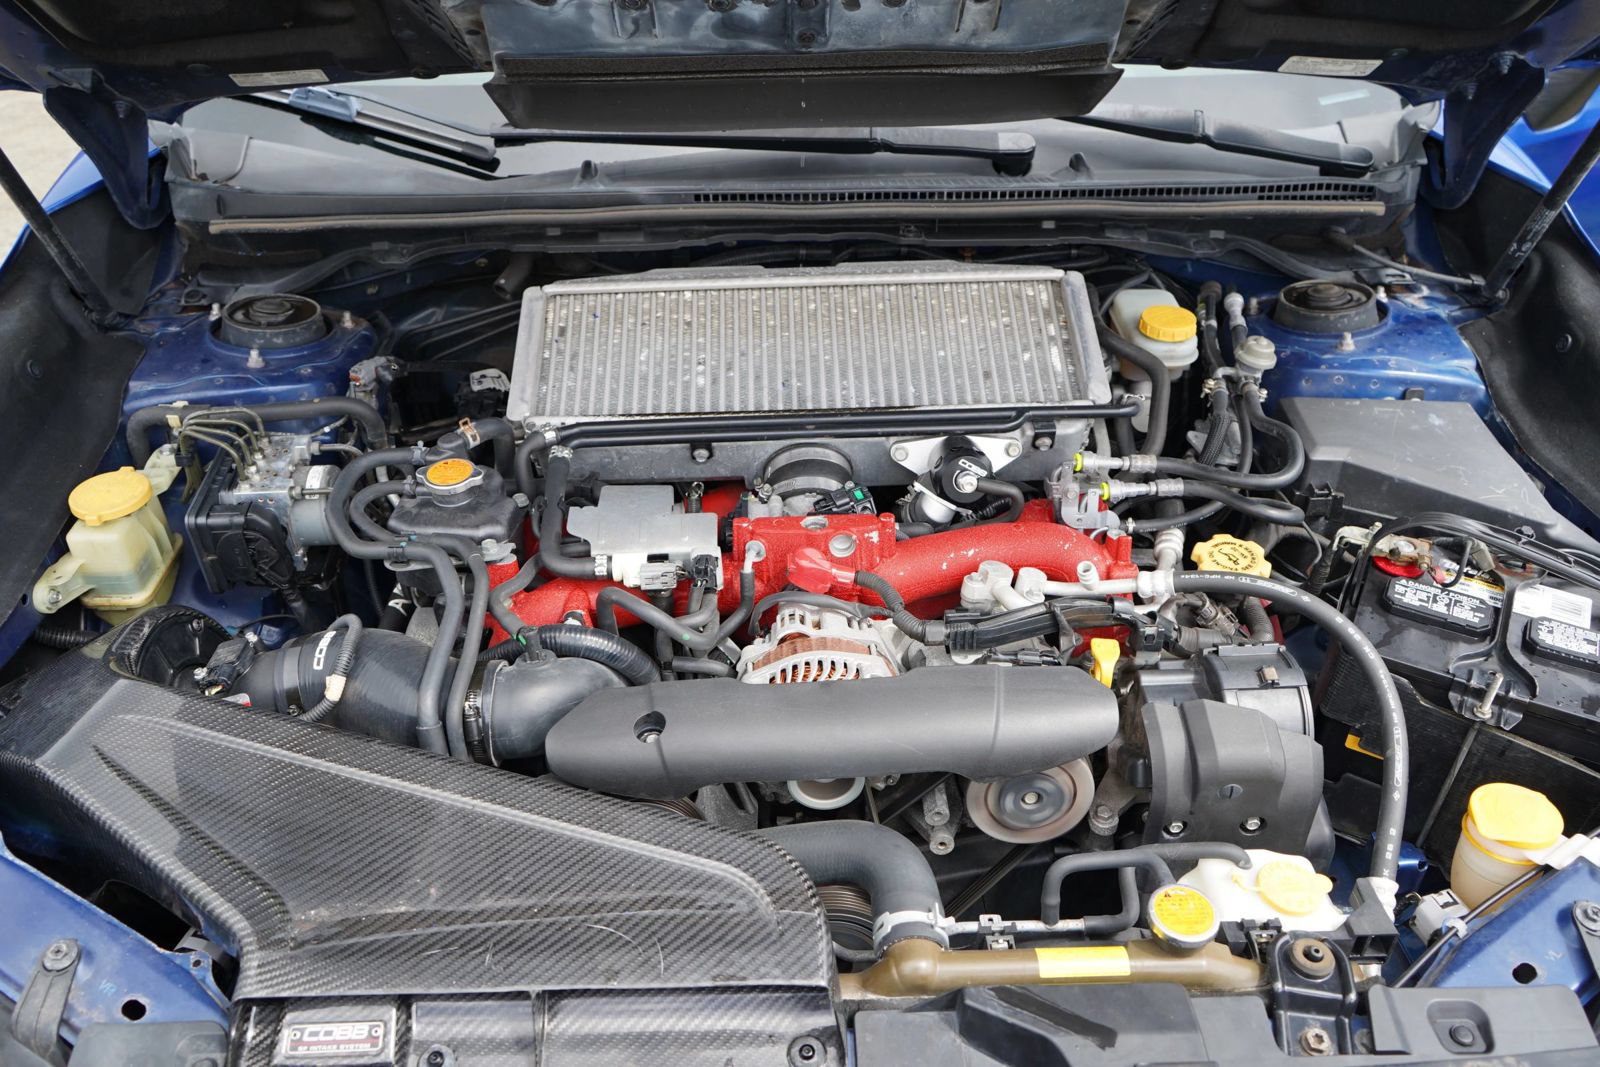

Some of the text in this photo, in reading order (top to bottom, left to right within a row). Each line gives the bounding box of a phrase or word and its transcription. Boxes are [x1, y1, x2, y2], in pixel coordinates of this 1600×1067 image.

[958, 458, 988, 477] COBB
[1407, 581, 1441, 597] DANGER
[1450, 593, 1480, 605] POISON
[302, 1025, 370, 1042] COBB
